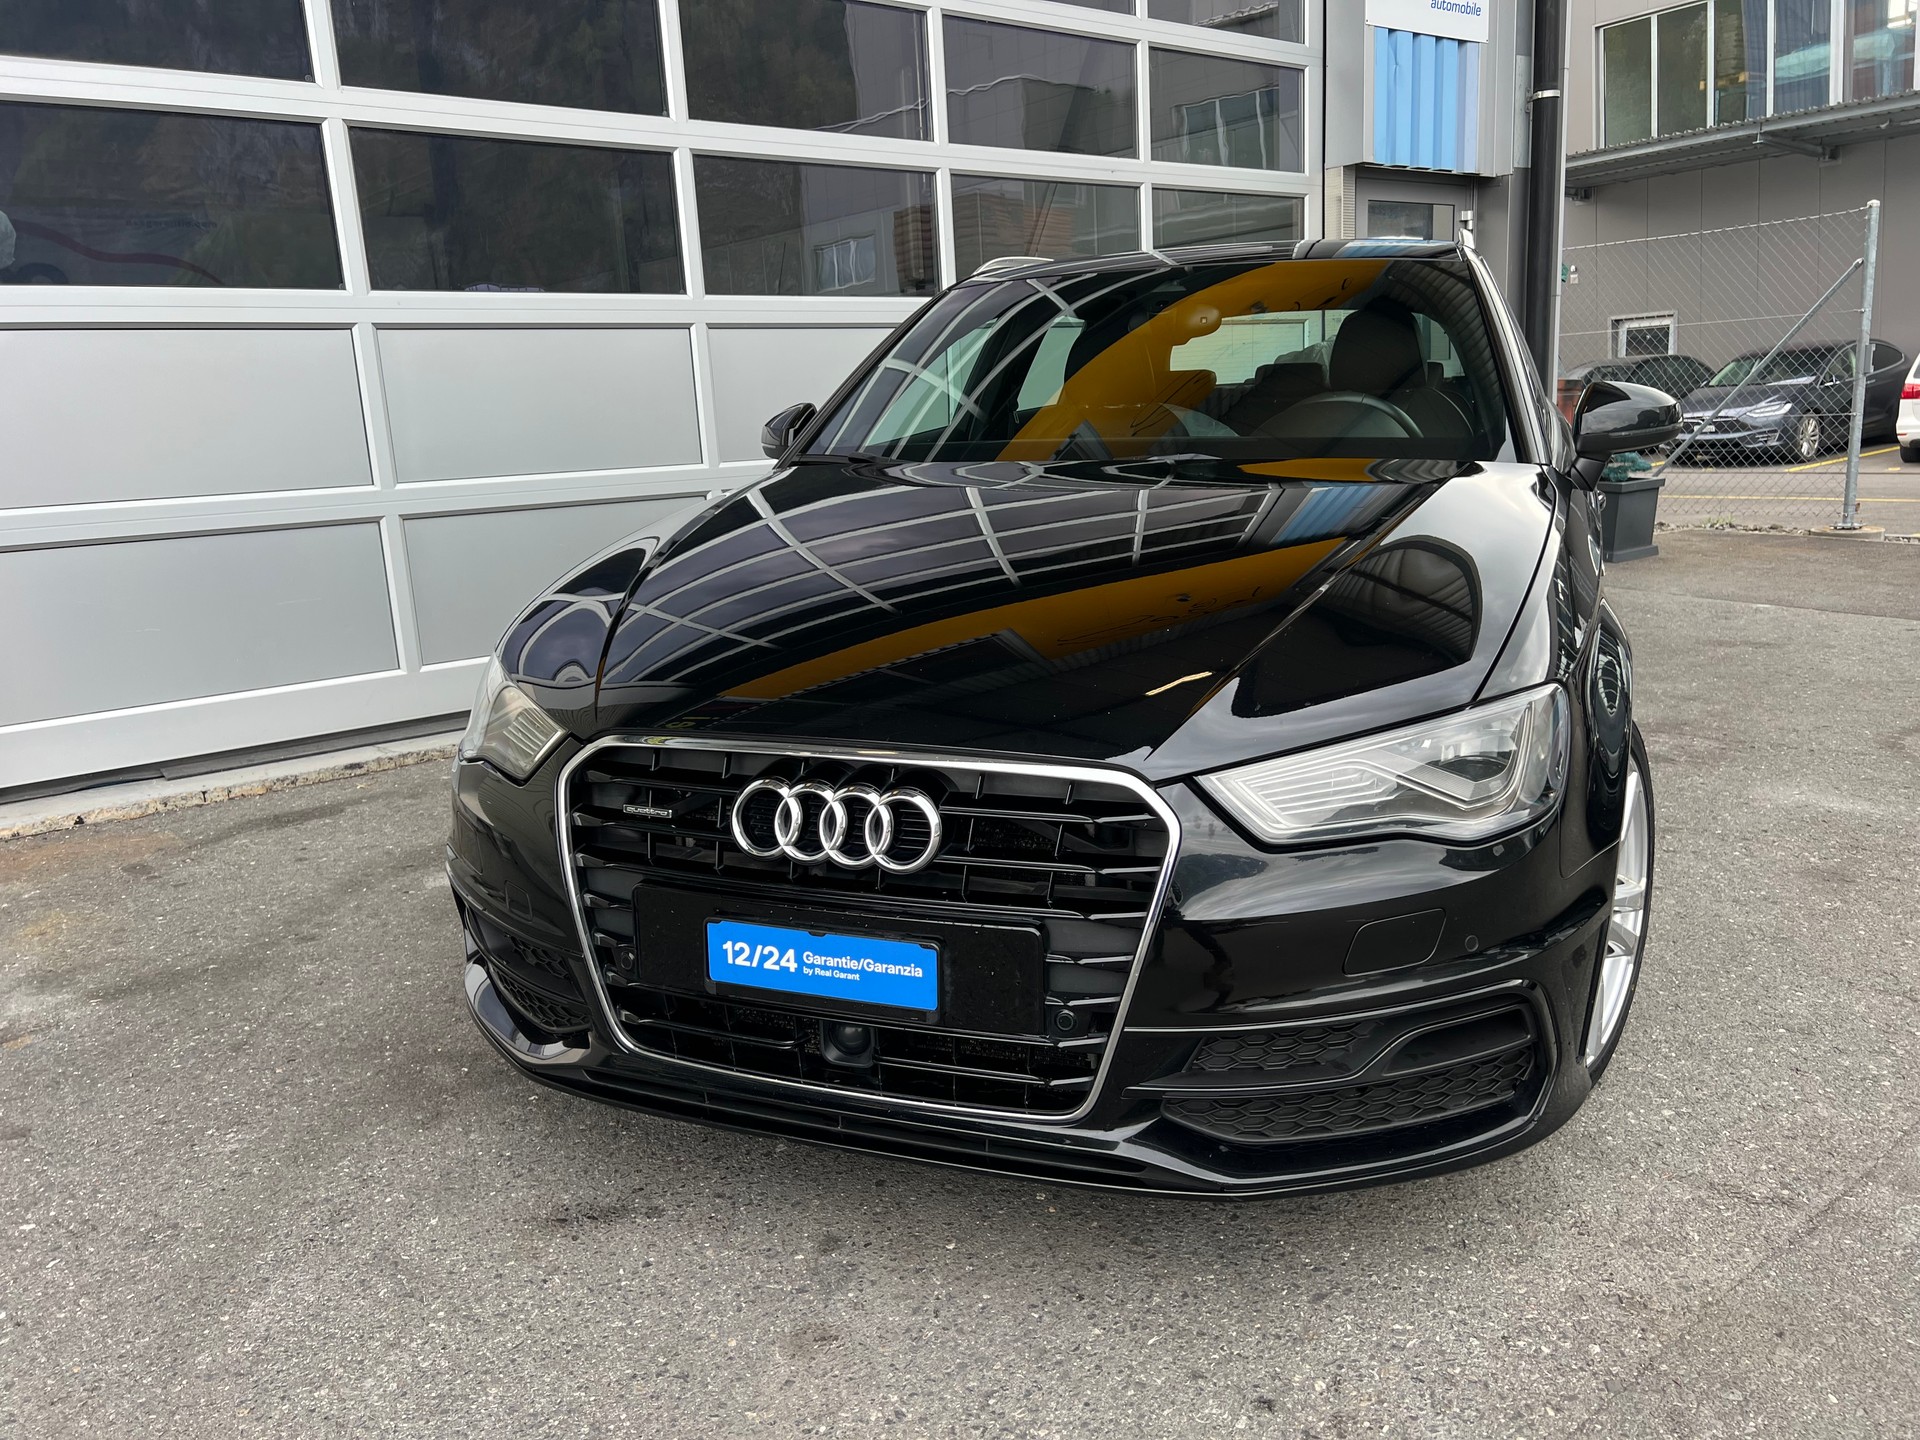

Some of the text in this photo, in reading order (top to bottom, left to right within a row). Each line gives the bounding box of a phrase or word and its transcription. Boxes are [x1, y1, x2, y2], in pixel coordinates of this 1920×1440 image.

[1430, 0, 1482, 16] automobile
[626, 806, 668, 816] quattro
[722, 940, 923, 978] 12/24 Garantie/Garanzia
[803, 966, 860, 981] by Real Garant
